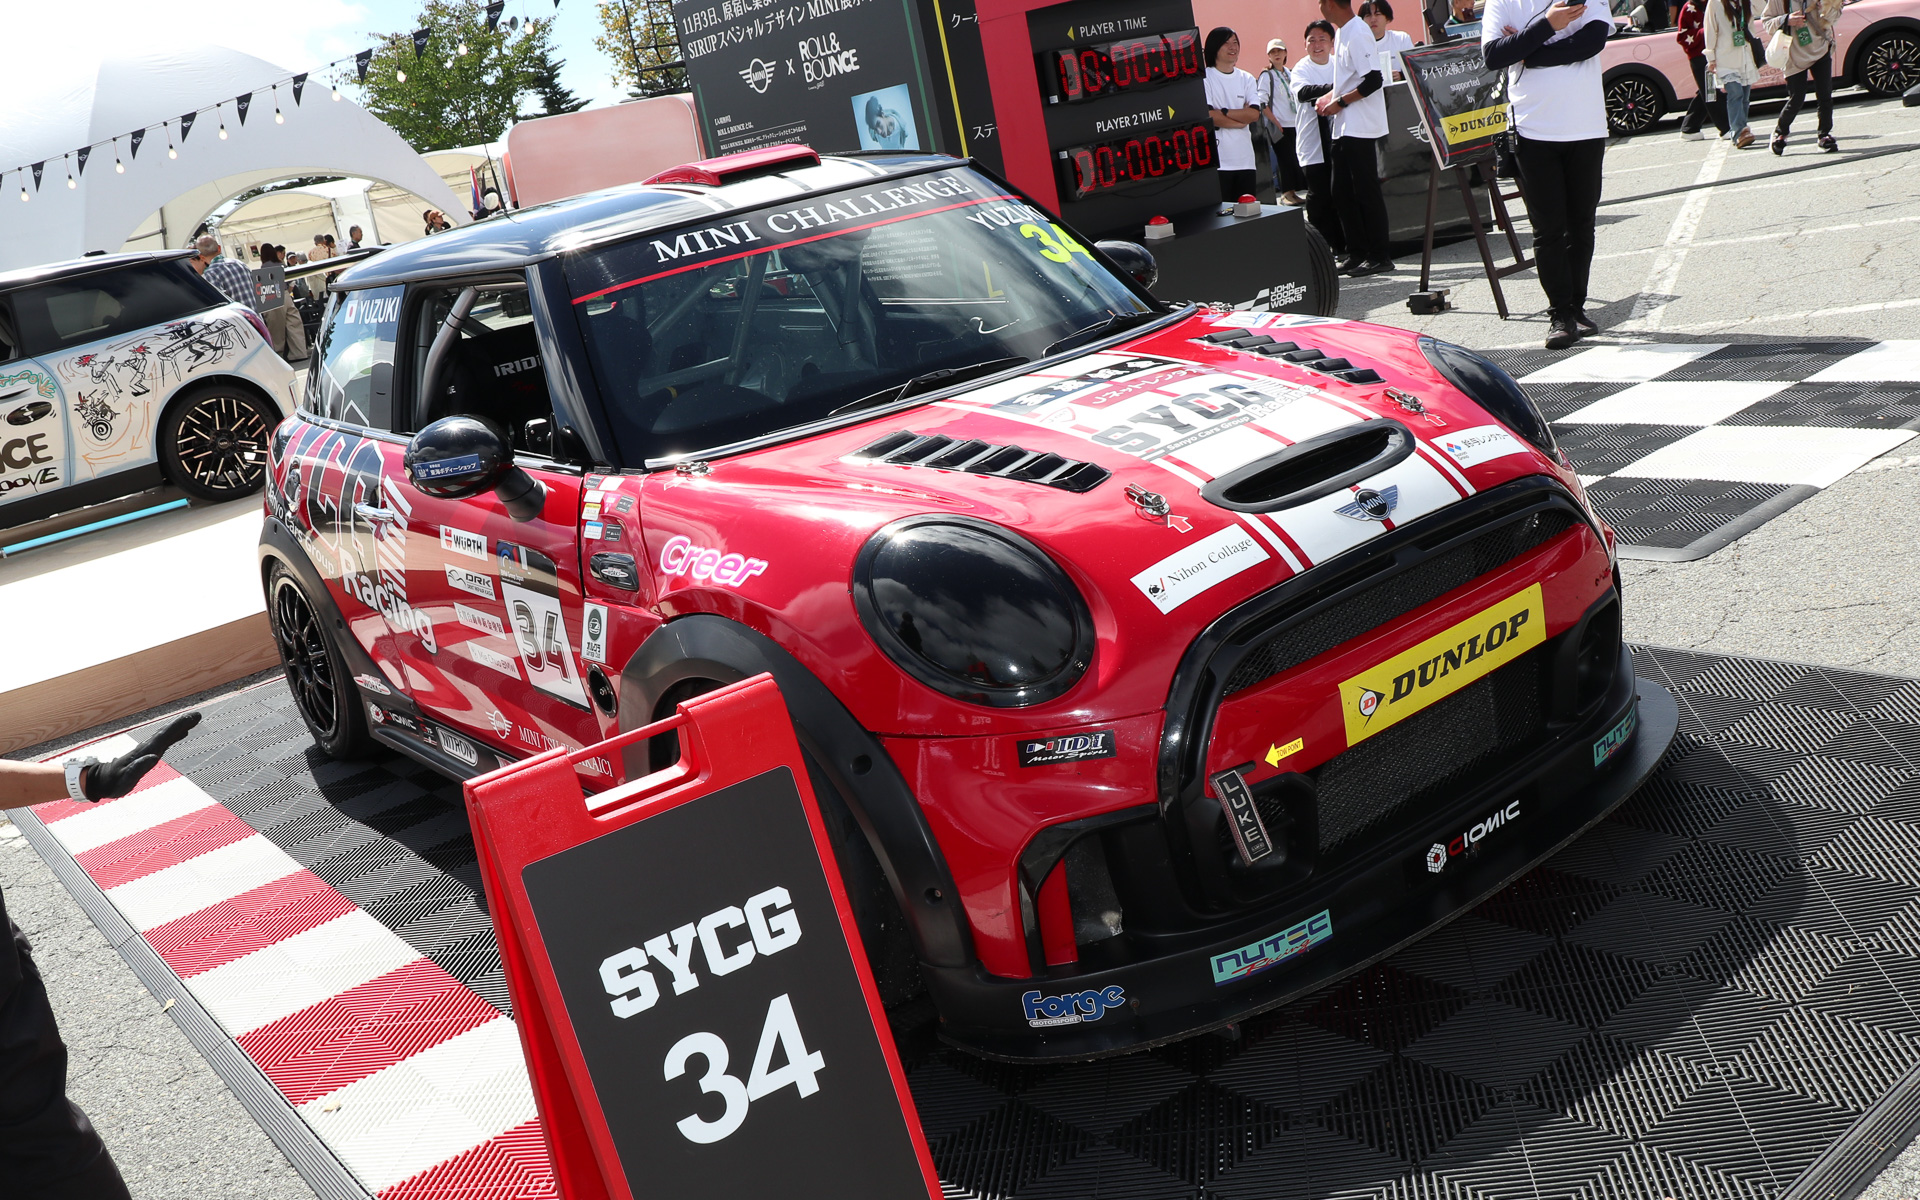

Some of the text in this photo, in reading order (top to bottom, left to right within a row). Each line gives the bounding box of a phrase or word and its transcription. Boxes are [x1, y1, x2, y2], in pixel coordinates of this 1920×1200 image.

[1080, 16, 1148, 38] PLAYER 1 TIME
[799, 32, 840, 61] ROLL&
[752, 69, 767, 82] MINI
[803, 49, 860, 83] BOUNCE
[1059, 35, 1198, 96] 00:00:00
[1421, 56, 1486, 82] タイヤ交換チャレン
[1450, 77, 1481, 92] supported
[1467, 94, 1477, 104] by
[973, 123, 998, 139] ステ
[1096, 109, 1163, 133] PLAYER 2 TIME
[1075, 126, 1212, 192] 00:00:00
[650, 176, 973, 263] MINI CHALLENGE
[966, 204, 1050, 231] YUZUKI
[1020, 223, 1096, 263] 34
[1271, 281, 1295, 295] JOHN
[1271, 285, 1307, 302] COOPER
[1271, 294, 1303, 309] WORKS
[359, 296, 400, 325] YUZUKI
[1243, 384, 1322, 418] Racing
[1091, 384, 1276, 453] SYCG
[1167, 416, 1250, 451] Sanyo Cars Group
[0, 432, 54, 474] CE
[1361, 496, 1386, 511] MINI
[285, 512, 304, 543] Cars
[304, 535, 336, 576] Group
[660, 534, 769, 588] Creer
[1167, 538, 1253, 586] Nihon Collage
[339, 546, 438, 656] Racing
[513, 600, 572, 684] 34
[1389, 609, 1529, 705] DUNLOP
[442, 732, 476, 760] NITRON
[518, 725, 541, 749] MINI
[1055, 733, 1106, 754] IDI
[1277, 741, 1302, 758] TOW POINT
[1027, 749, 1108, 764] Motor Sports
[1223, 782, 1261, 843] LUKE
[598, 886, 802, 1020] SYCG
[1022, 985, 1126, 1022] Forge
[1032, 1017, 1078, 1027] MOTORSPORT
[663, 993, 826, 1145] 34
